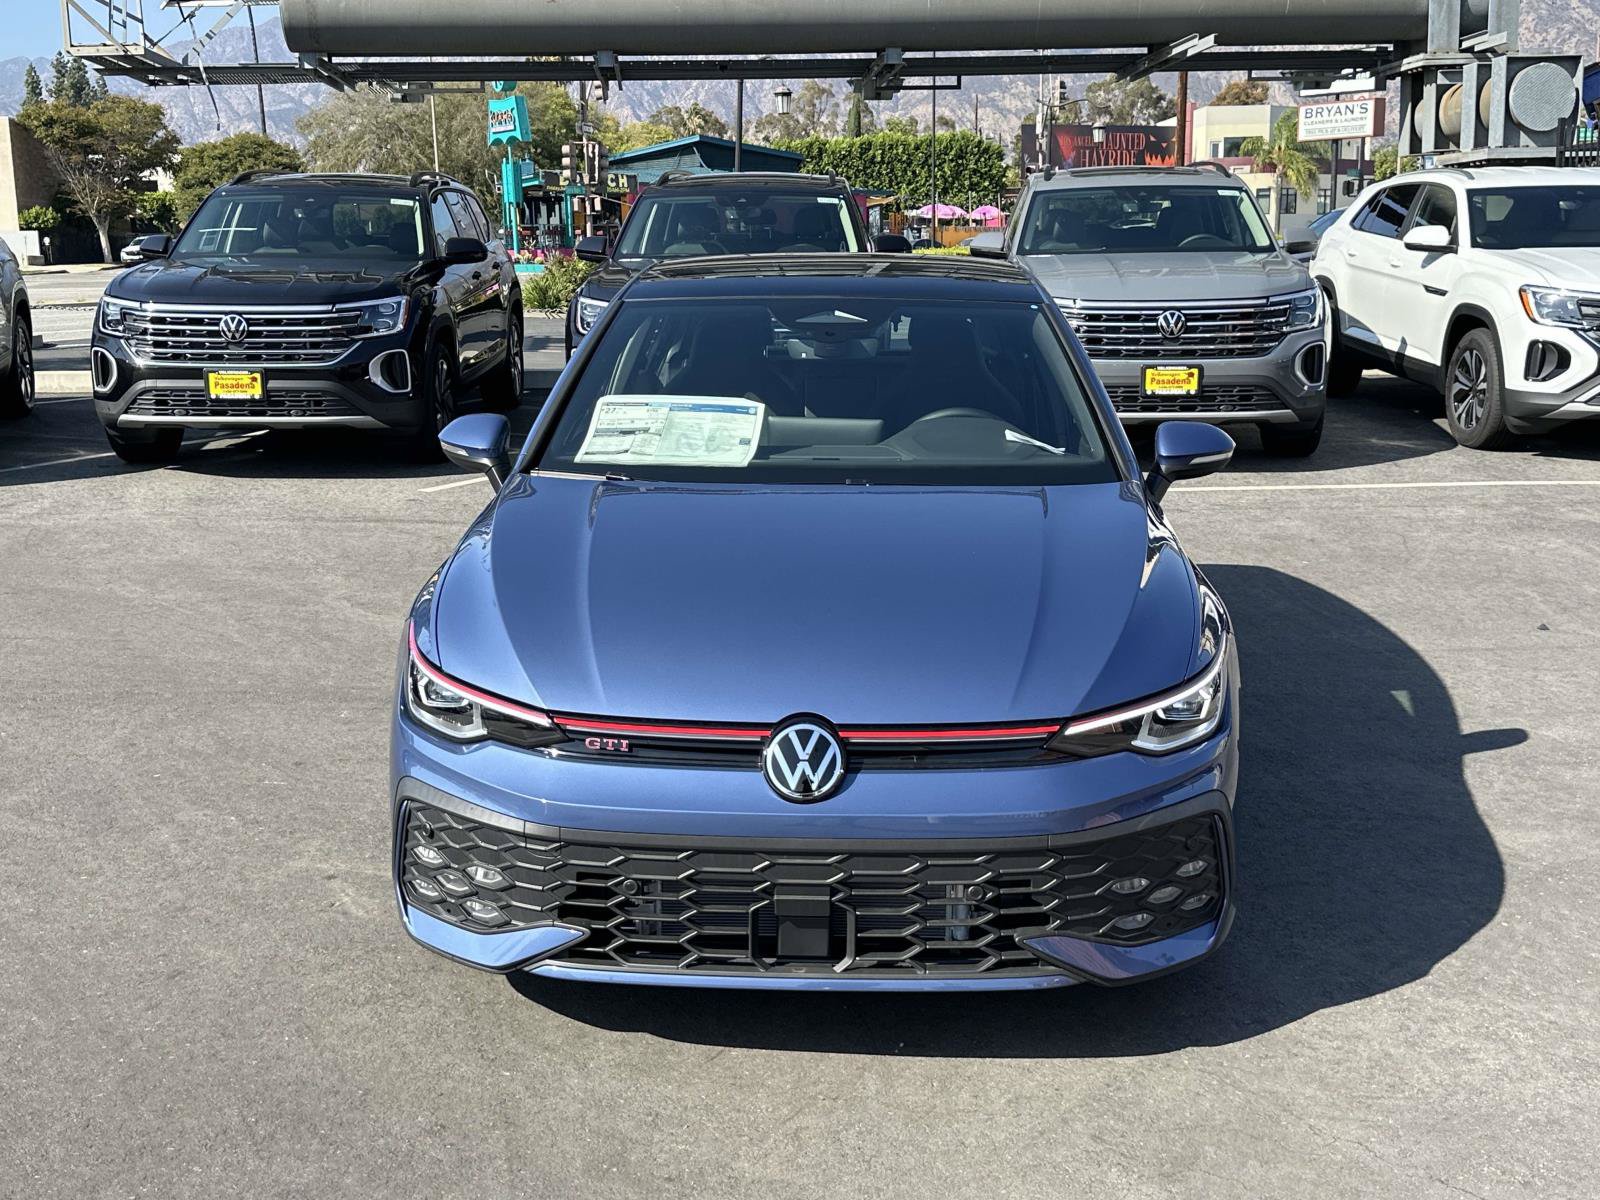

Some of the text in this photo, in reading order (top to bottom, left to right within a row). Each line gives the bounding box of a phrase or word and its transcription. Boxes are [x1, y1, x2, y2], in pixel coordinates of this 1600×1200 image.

[1304, 103, 1369, 119] BRYAN'S
[1304, 118, 1333, 126] CLEANERS
[1080, 149, 1138, 167] HAYRIDE
[214, 381, 255, 390] Pasadena
[1150, 377, 1191, 386] Pasadena
[585, 737, 629, 752] GTI
[766, 723, 842, 798] VW
